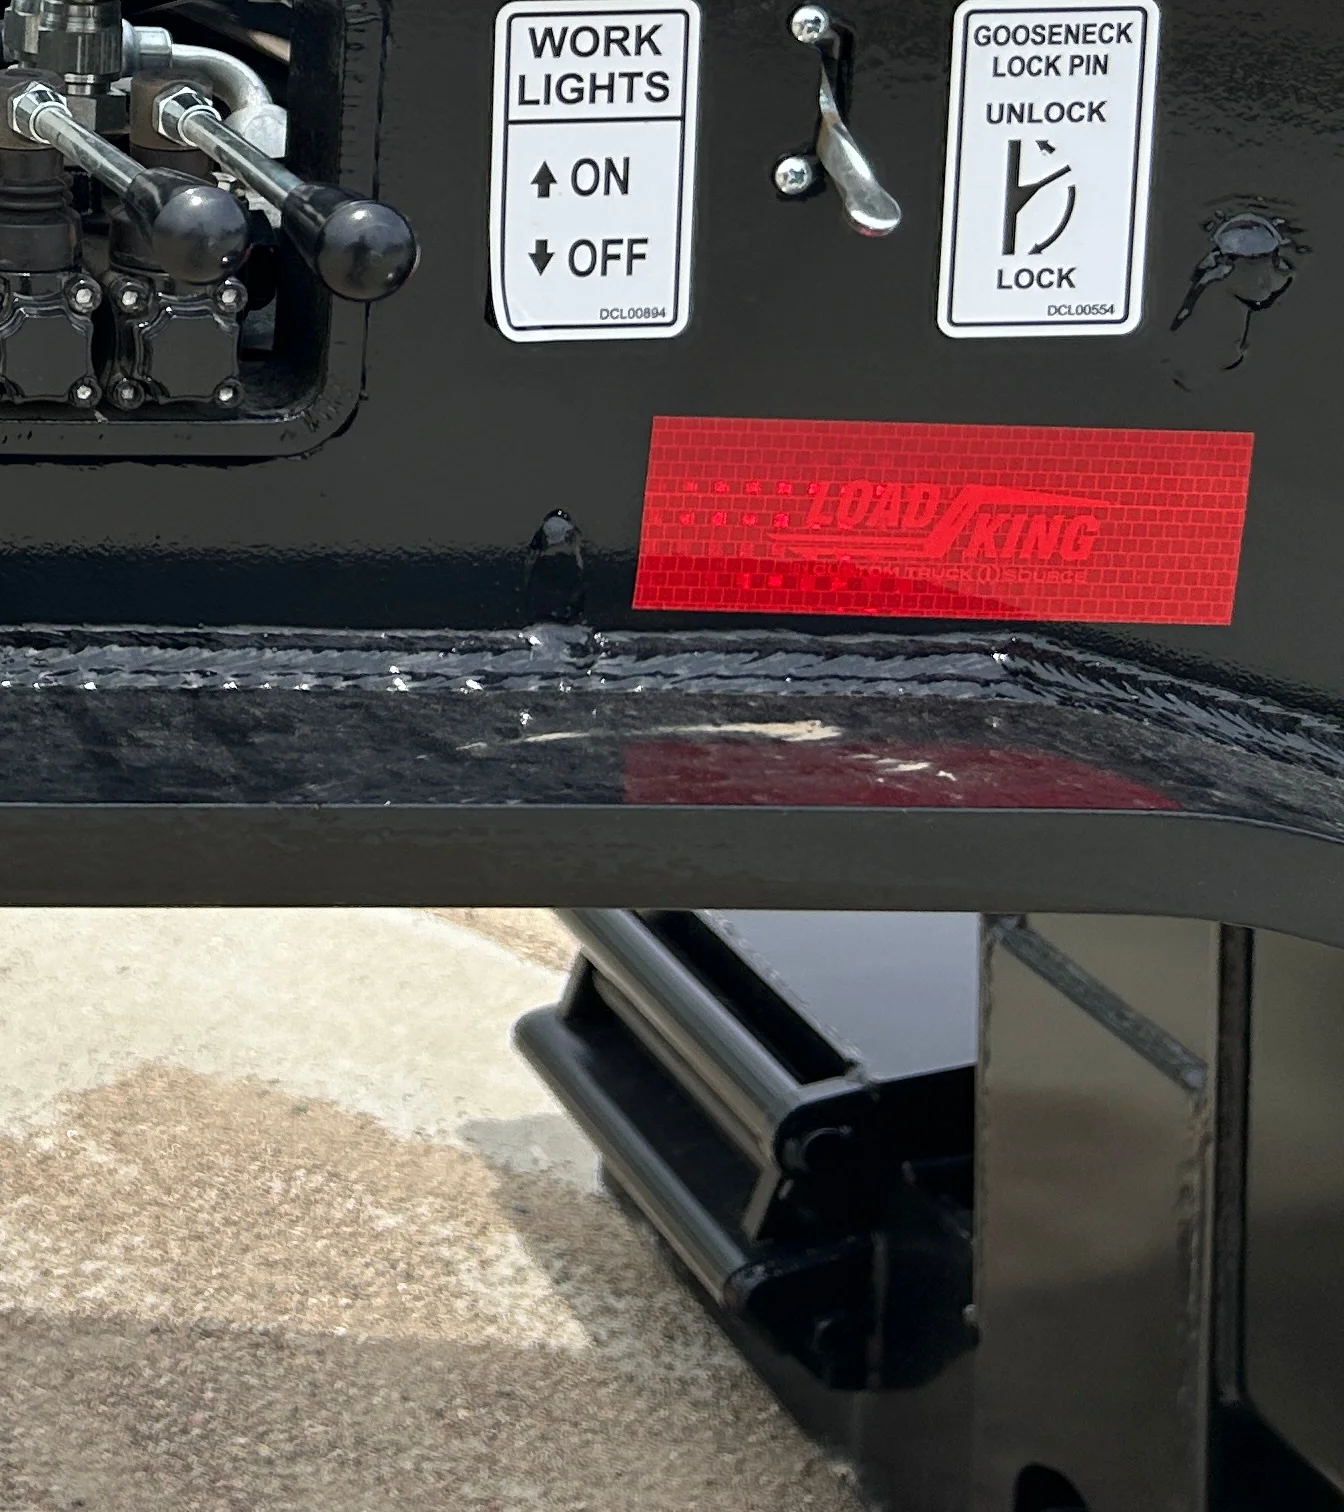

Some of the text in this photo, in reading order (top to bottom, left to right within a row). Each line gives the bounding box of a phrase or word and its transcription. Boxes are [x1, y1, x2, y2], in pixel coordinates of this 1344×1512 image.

[529, 25, 662, 58] WORK
[974, 23, 1133, 46] GOOSENECK
[993, 54, 1108, 77] LOCK PIN
[519, 71, 669, 105] LIGHTS
[987, 101, 1107, 124] UNLOCK
[572, 157, 629, 196] ON
[569, 238, 648, 277] OFF
[997, 268, 1076, 289] LOCK
[600, 307, 665, 320] DCL00894
[1048, 304, 1115, 316] DCL00554
[806, 481, 1099, 561] LOAD KING
